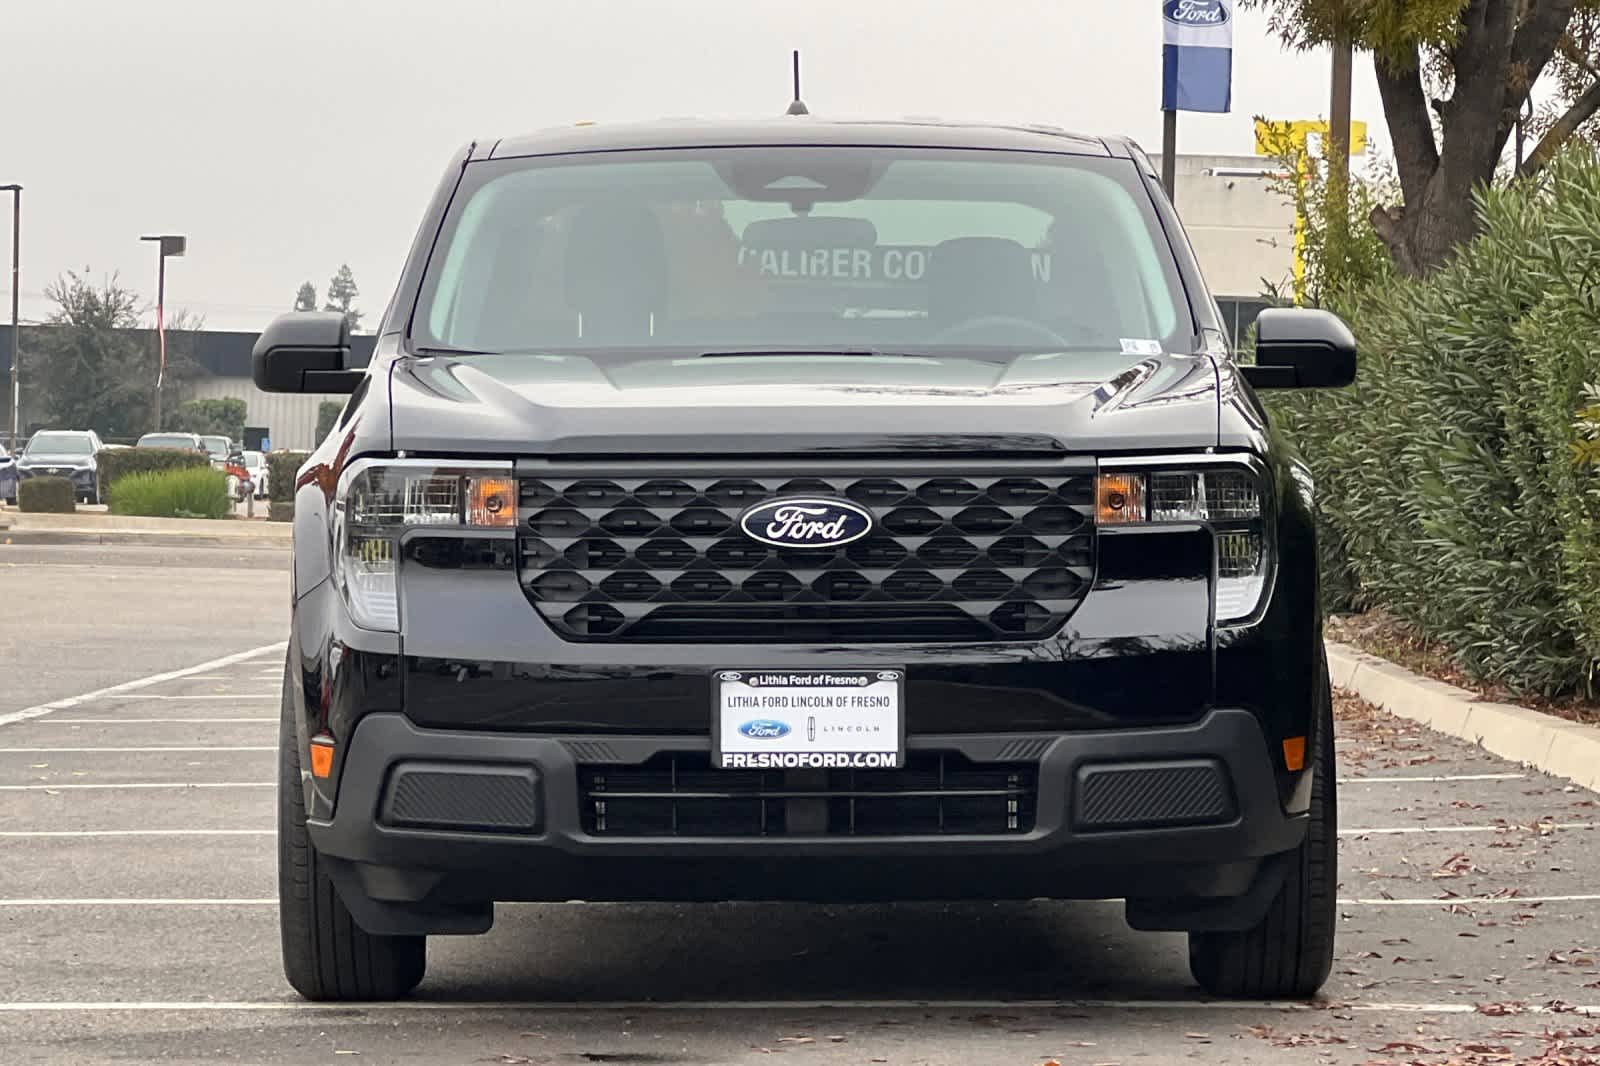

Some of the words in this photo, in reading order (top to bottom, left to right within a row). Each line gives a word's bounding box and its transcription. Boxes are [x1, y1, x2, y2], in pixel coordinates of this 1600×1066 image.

[1173, 0, 1220, 21] Ford
[766, 506, 847, 539] Ford
[760, 675, 788, 685] Lithia
[789, 675, 811, 685] Ford
[812, 675, 825, 685] of
[825, 675, 858, 685] Fresno
[727, 696, 760, 708] LITHIA
[762, 696, 789, 708] FORD
[791, 696, 833, 708] LINCOLN
[835, 696, 848, 708] OF
[851, 696, 890, 708] FRESNO
[748, 720, 781, 736] Ford
[722, 753, 897, 768] FRESNOFORD.COM
